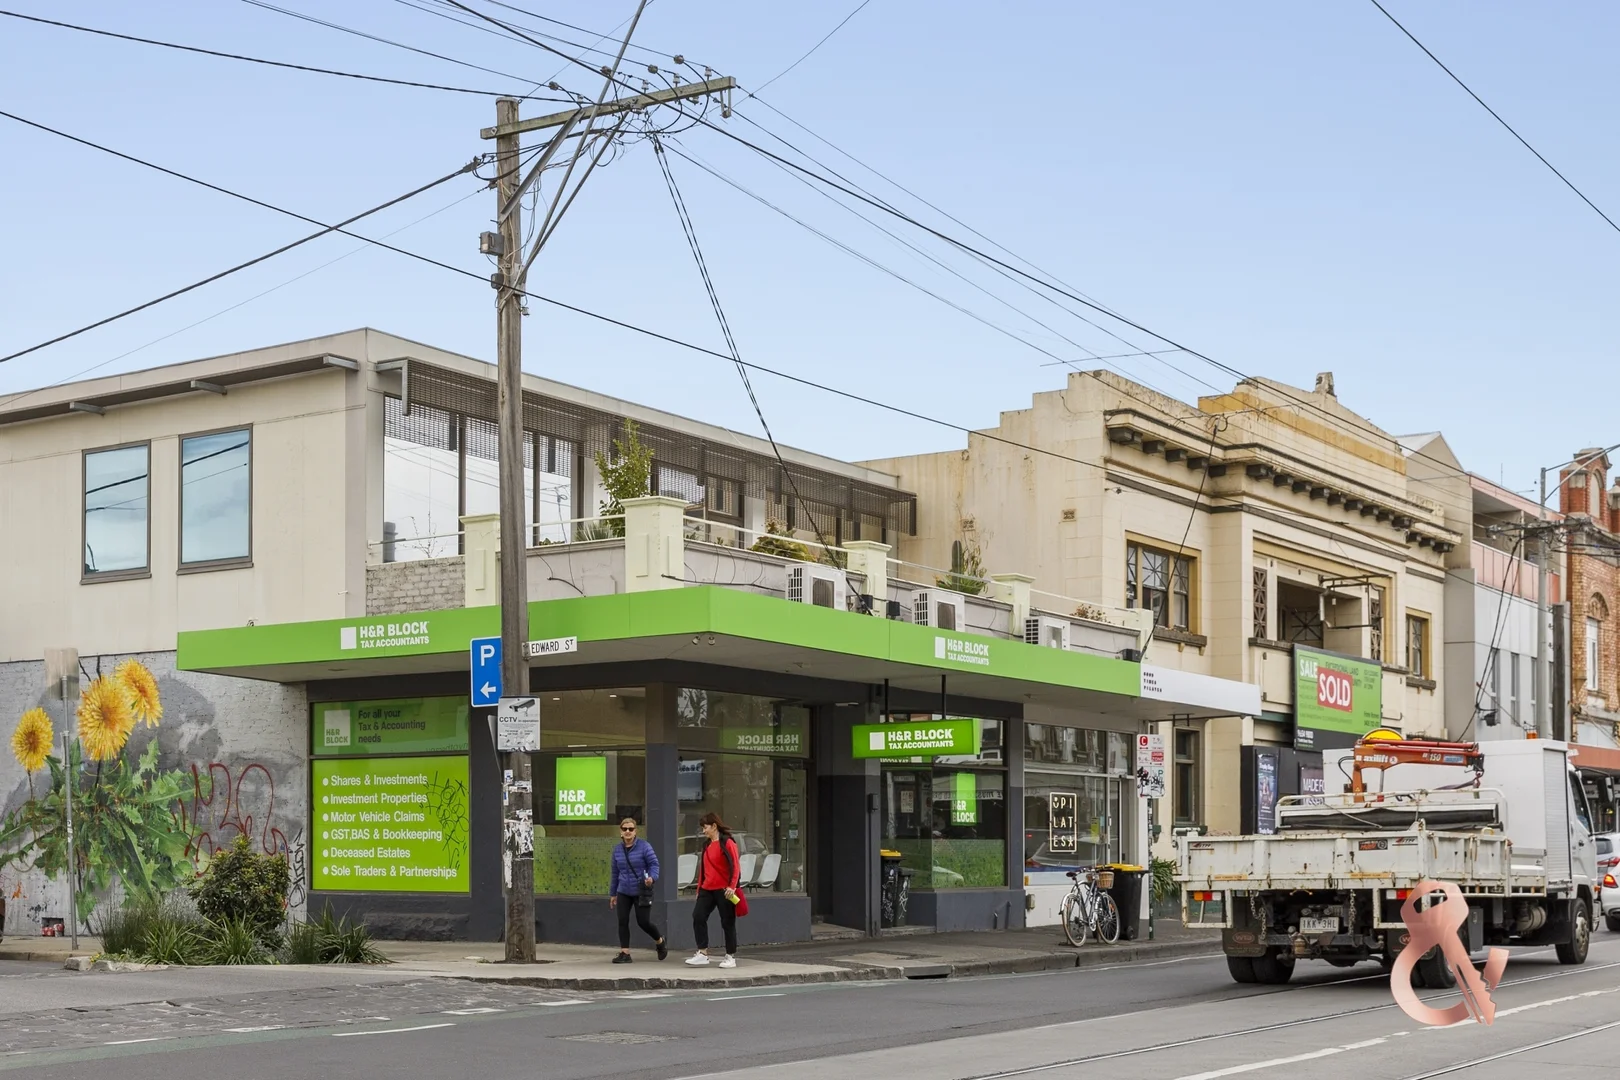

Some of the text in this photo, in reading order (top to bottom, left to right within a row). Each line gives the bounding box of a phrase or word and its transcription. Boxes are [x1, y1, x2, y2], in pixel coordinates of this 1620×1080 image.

[360, 621, 429, 639] H&R BLOCK
[361, 635, 430, 649] TAX ACCOUNTANTS
[531, 639, 574, 654] EDWARD ST
[947, 638, 989, 657] H&R BLOCK
[480, 644, 496, 667] P
[947, 652, 990, 666] TAX ACCOUNTANTS
[1299, 659, 1318, 679] SALE
[1319, 673, 1351, 707] SOLD
[357, 709, 401, 721] For all your
[358, 720, 426, 731] Tax & Accounting
[325, 728, 341, 736] H&R
[888, 729, 954, 741] H&R BLOCK
[325, 735, 349, 744] BLOCK
[358, 734, 382, 743] needs
[888, 740, 954, 750] TAX ACCOUNTANTS
[1428, 753, 1441, 761] 150
[330, 773, 429, 786] Shares & Investments
[330, 792, 428, 805] Investment Properties
[558, 789, 586, 802] H&R
[558, 803, 602, 816] BLOCK
[951, 800, 967, 811] H&R
[330, 810, 425, 822] Motor Vehicle Claims
[952, 812, 976, 823] BLOCK
[1053, 816, 1074, 828] LAT
[330, 828, 442, 842] GST,BAS & Bookkeeping
[330, 847, 411, 858] Deceased Estates
[330, 865, 457, 879] Sole Traders & Partnerships
[1322, 917, 1337, 929] 3HL
